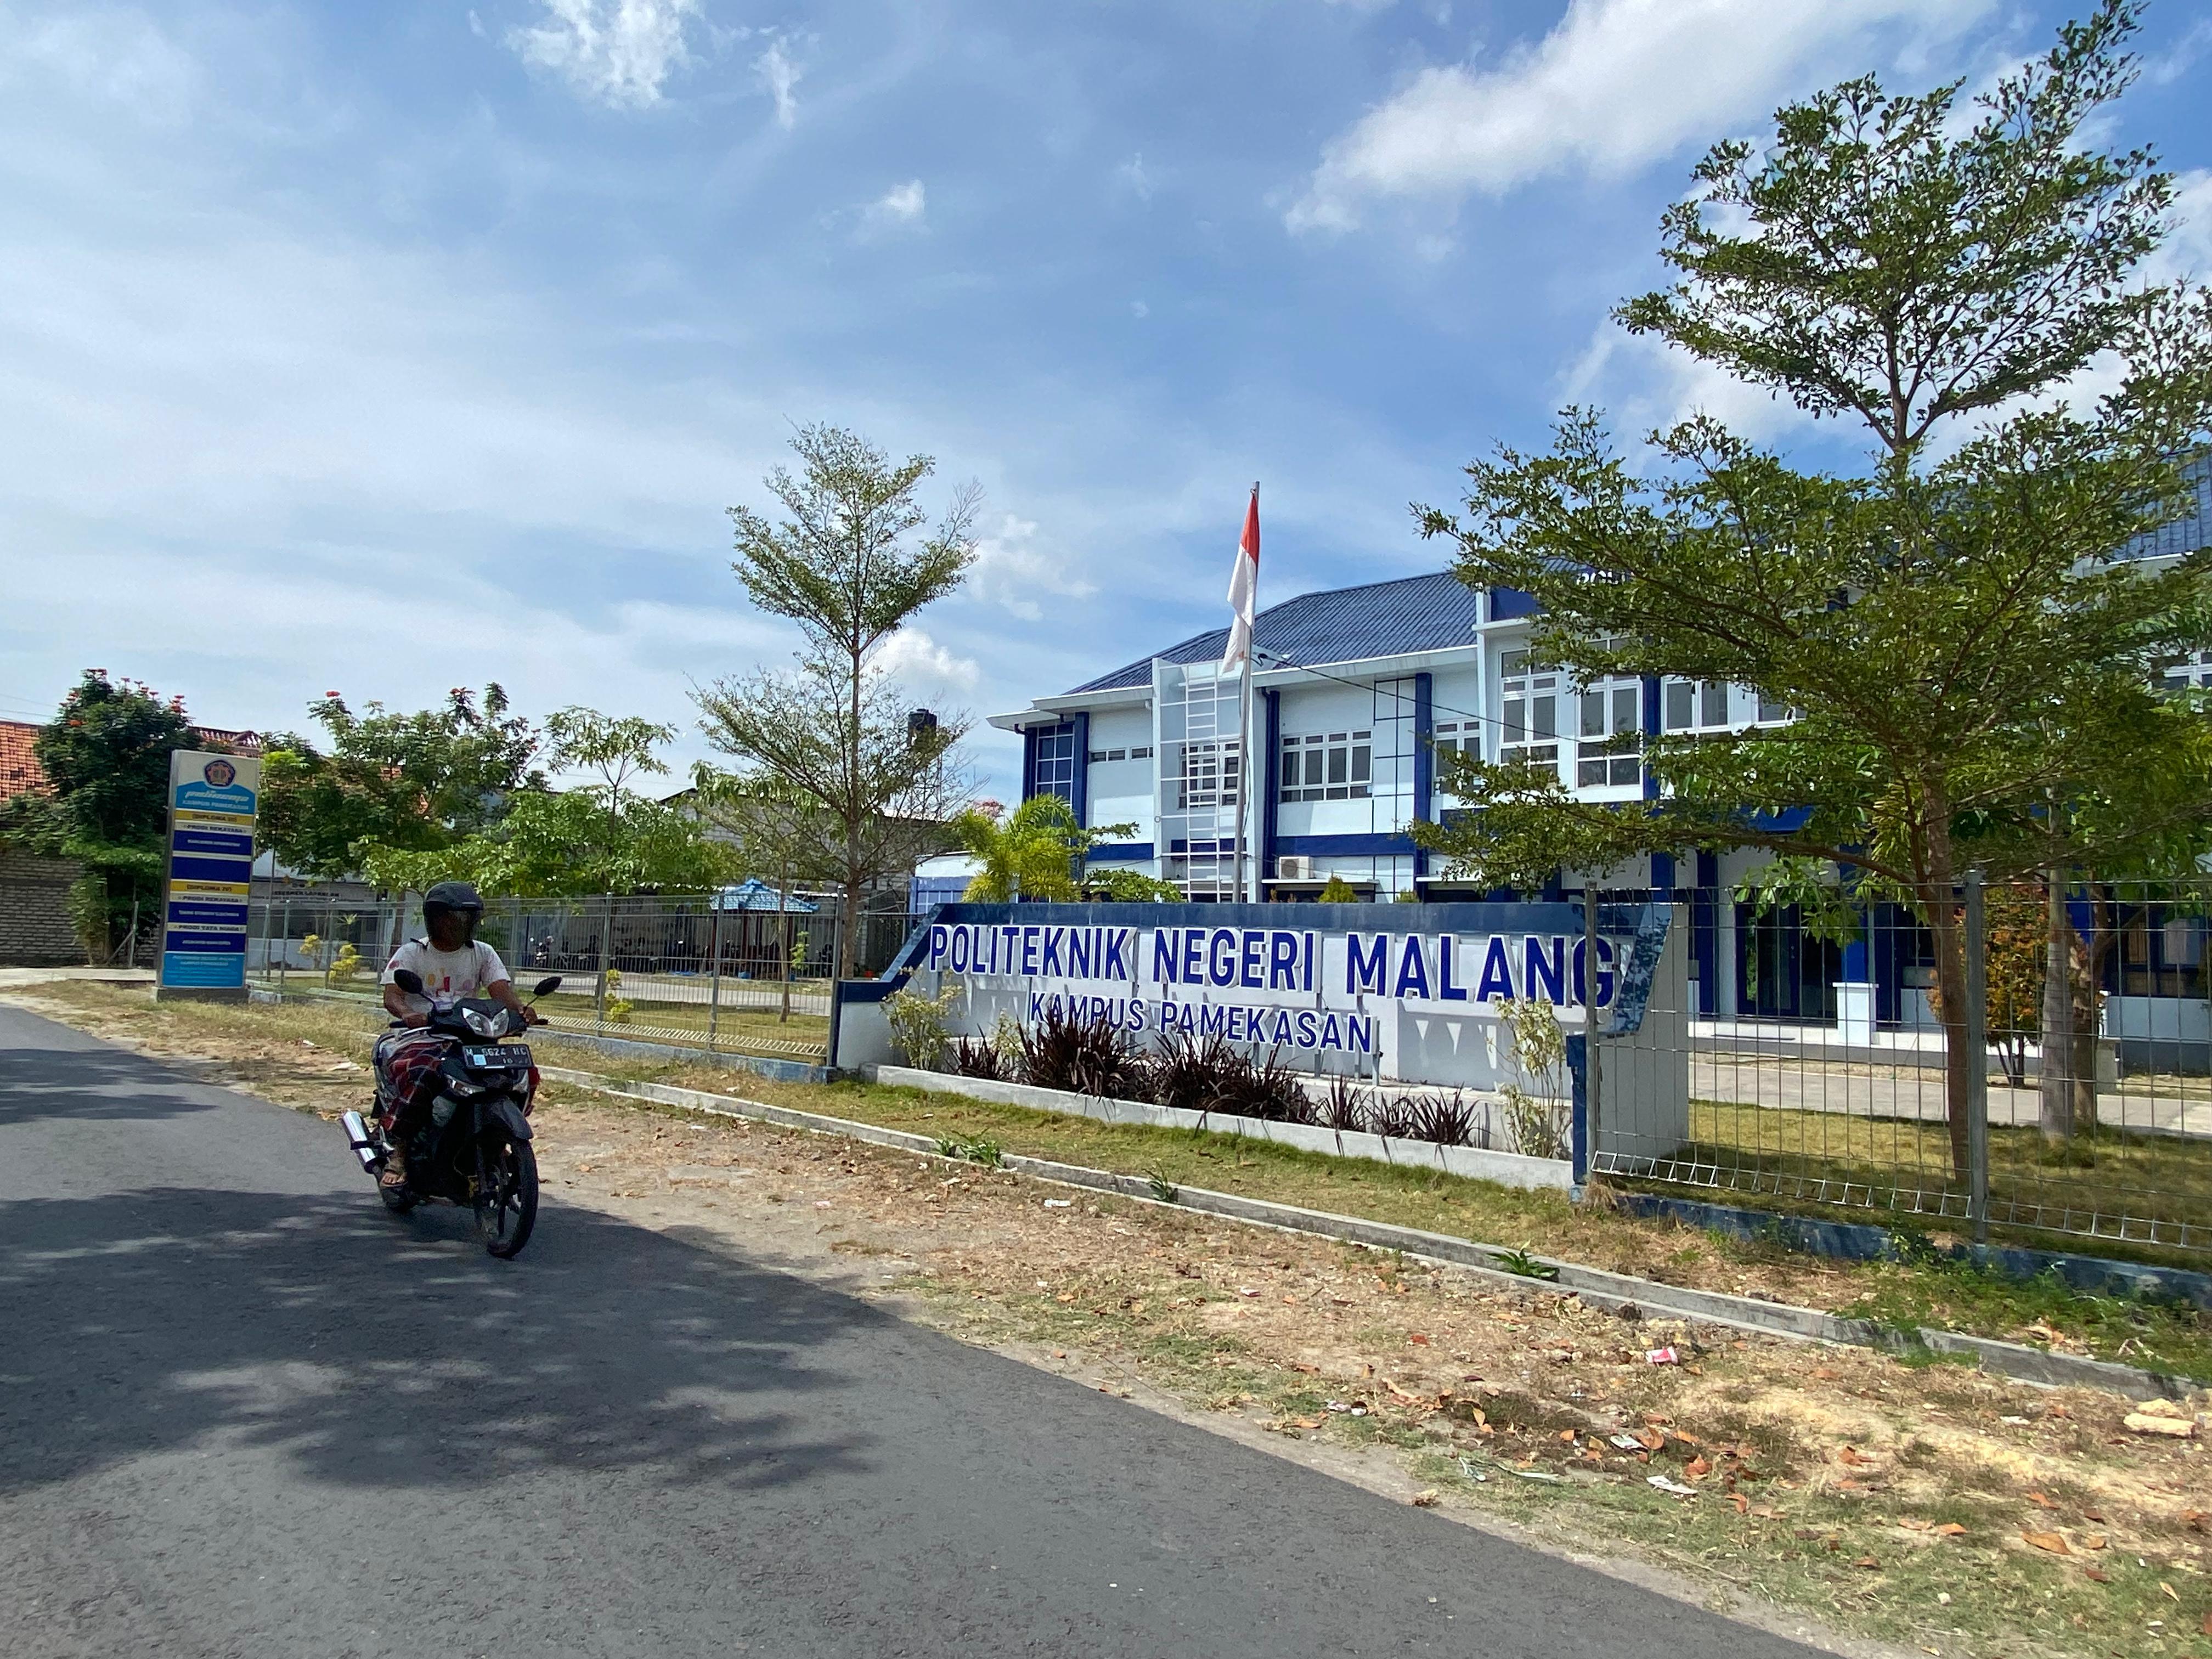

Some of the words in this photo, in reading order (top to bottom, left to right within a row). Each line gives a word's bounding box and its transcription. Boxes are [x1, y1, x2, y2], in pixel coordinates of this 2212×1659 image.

[929, 925, 1130, 980] POLITEKNIK
[1152, 927, 1315, 990] NEGERI
[1346, 933, 1616, 1008] MALANG
[1030, 992, 1144, 1034] KAMPUS
[1159, 1000, 1373, 1053] PAMEKASAN
